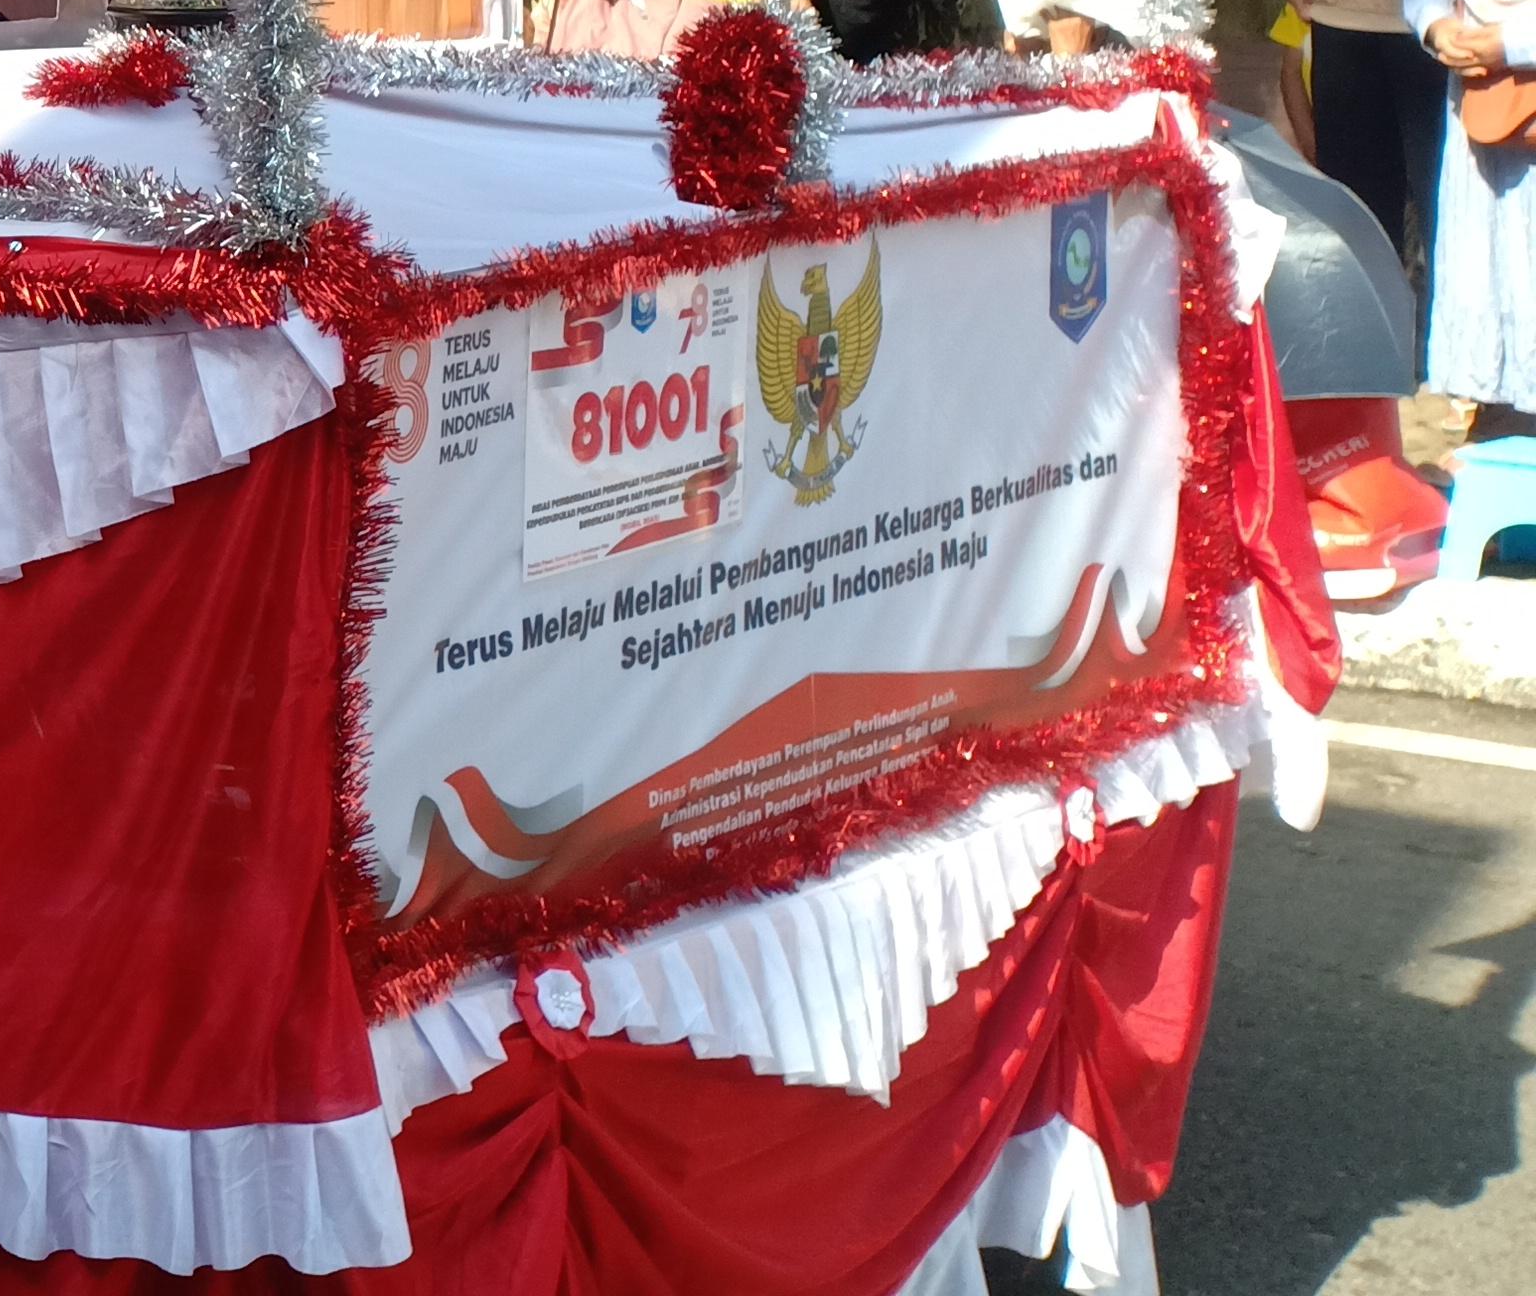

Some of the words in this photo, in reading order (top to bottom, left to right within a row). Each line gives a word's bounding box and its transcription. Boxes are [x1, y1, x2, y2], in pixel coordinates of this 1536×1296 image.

[444, 329, 491, 356] TERUS
[442, 353, 500, 384] MELAJU
[442, 382, 490, 410] UNTUK
[571, 364, 710, 465] 81001
[440, 402, 515, 438] INDONESIA
[439, 437, 479, 465] MAJU
[434, 628, 514, 674] Terus
[521, 599, 606, 652] Melaju
[613, 568, 703, 623] Melalui
[710, 525, 868, 596] Pembangunan
[874, 494, 965, 545] Keluarga
[971, 463, 1074, 515] Berkualitas
[1080, 452, 1118, 482] dan
[621, 611, 736, 671] Sejahtera
[744, 580, 826, 633] Menuju
[832, 550, 934, 605] Indonesia
[940, 532, 988, 572] Maju
[649, 783, 686, 808] Dinas
[690, 745, 782, 791] Pemberdayaan
[784, 727, 850, 761] Perempuan
[854, 700, 928, 736] Perlindungan
[661, 790, 741, 830] Administrasi
[744, 758, 833, 802] Kependudukan
[836, 737, 903, 768] Pencatatan
[905, 723, 929, 747] Sipil
[930, 716, 950, 735] dan
[673, 804, 762, 850] Pengendalian
